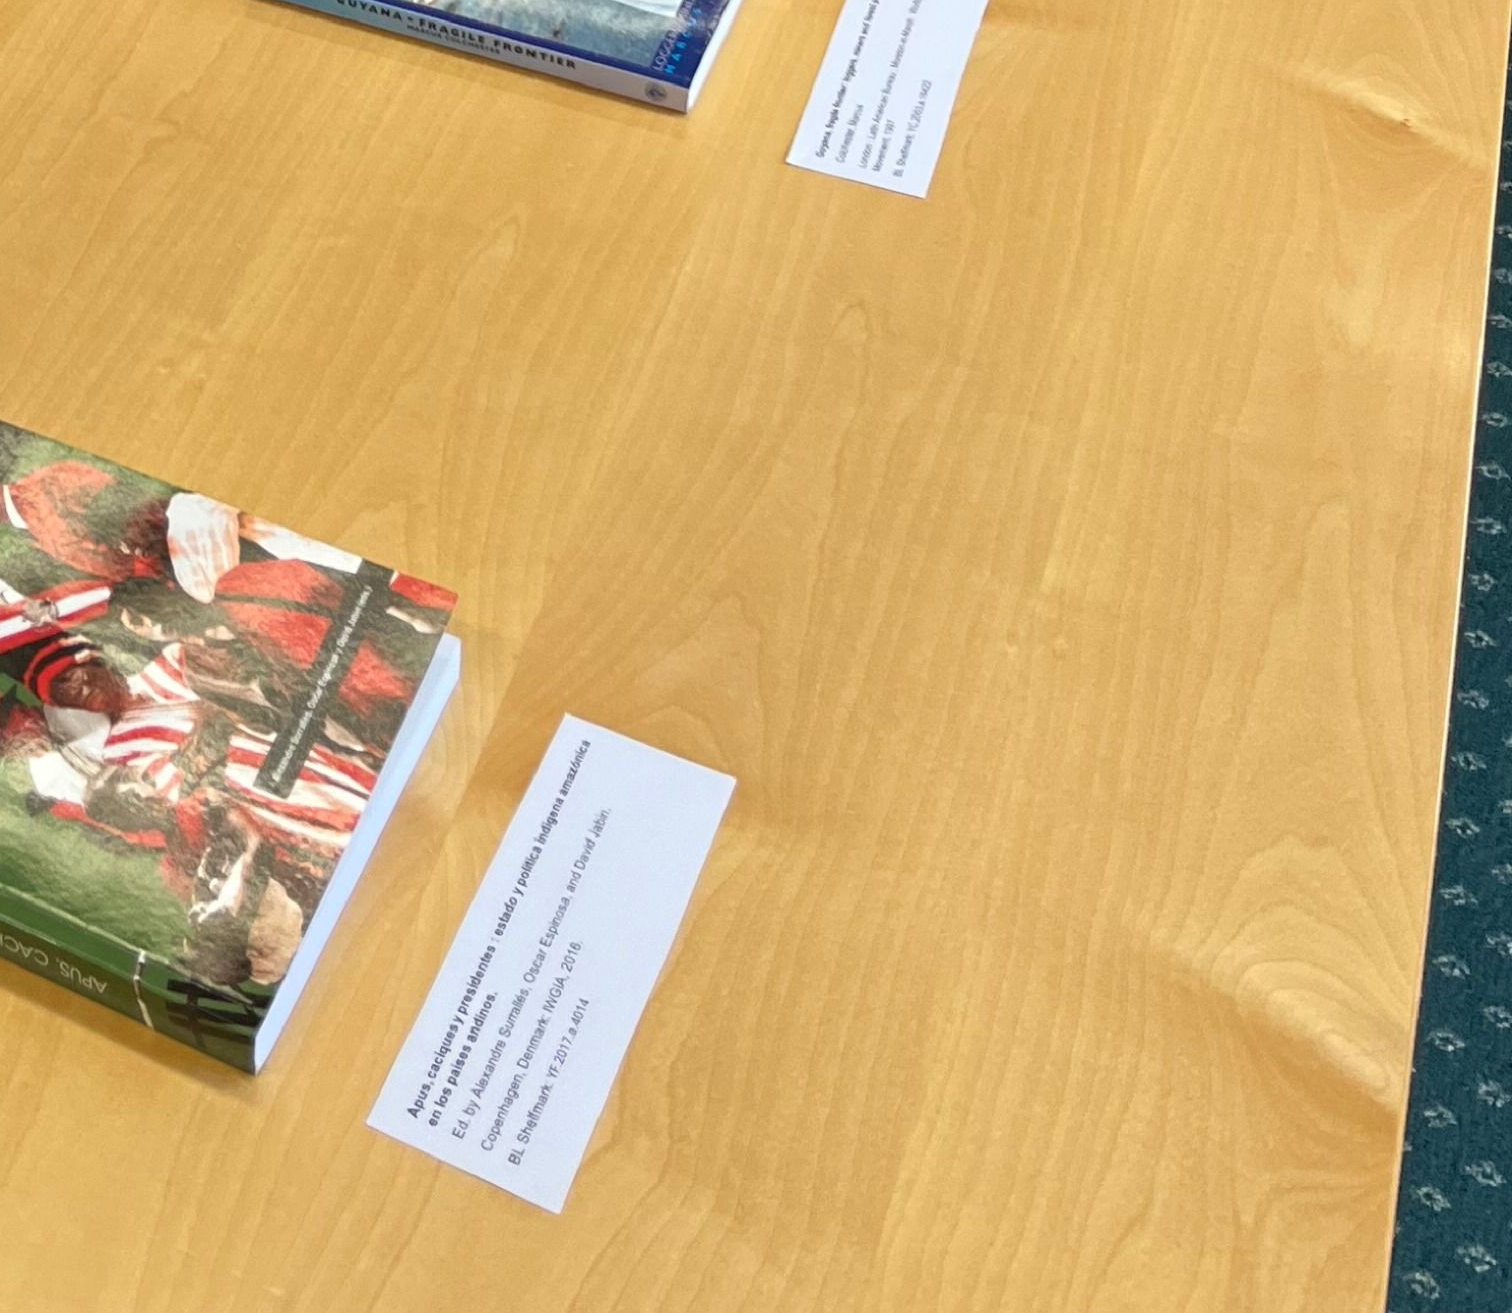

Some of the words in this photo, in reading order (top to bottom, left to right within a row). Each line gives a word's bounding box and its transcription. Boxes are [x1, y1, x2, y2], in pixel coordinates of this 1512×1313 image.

[418, 18, 485, 44] FRAGILE
[493, 39, 576, 69] FRONTIER
[573, 836, 596, 871] David
[512, 886, 525, 897] y
[564, 869, 582, 893] and
[493, 896, 518, 937] estado
[538, 896, 572, 948] Espinosa,
[457, 945, 496, 1016] presidentes
[522, 948, 547, 984] Oscar
[452, 1014, 465, 1025] y
[466, 992, 498, 1043] andinos.
[497, 988, 532, 1038] Surrallés,
[427, 1023, 459, 1079] caciques
[470, 1039, 506, 1099] Alexandre
[480, 1073, 526, 1152] Copenhagen,
[541, 975, 570, 1013] IWGIA,
[406, 1081, 435, 1119] Apus,
[433, 1086, 453, 1108] los
[461, 1099, 481, 1117] by
[427, 1109, 443, 1127] en
[451, 1117, 469, 1140] Ed.
[507, 1146, 526, 1166] BL
